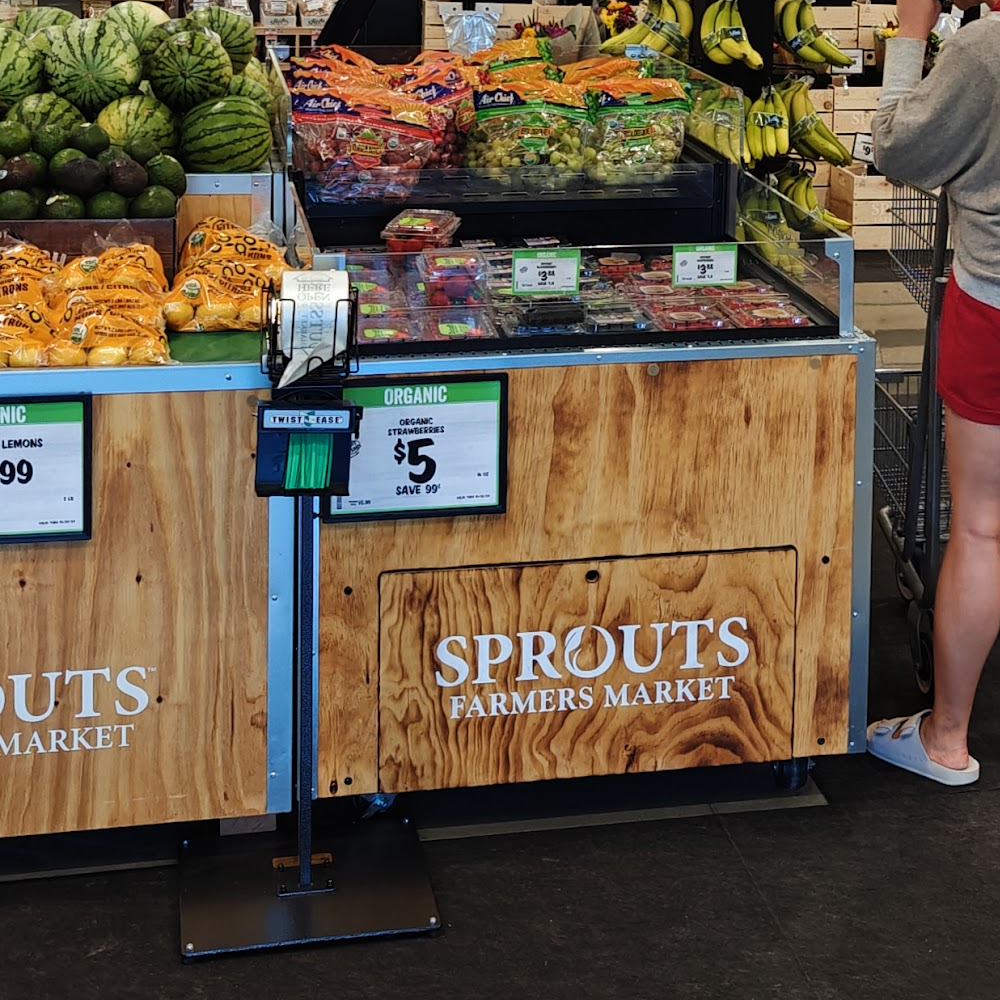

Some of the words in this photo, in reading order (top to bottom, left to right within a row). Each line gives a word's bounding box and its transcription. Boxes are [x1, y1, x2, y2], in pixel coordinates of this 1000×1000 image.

[384, 385, 448, 405] ORGANIC
[272, 416, 302, 424] TWIST
[316, 416, 341, 424] EASE
[399, 417, 433, 426] ORGANIC
[387, 426, 445, 436] STRAWBERRIES
[2, 438, 43, 449] LEMONS
[394, 438, 437, 484] $5
[396, 485, 421, 495] SAVE
[434, 617, 750, 688] SPROUTS
[449, 686, 594, 720] FARMERS
[603, 675, 736, 709] MARKET
